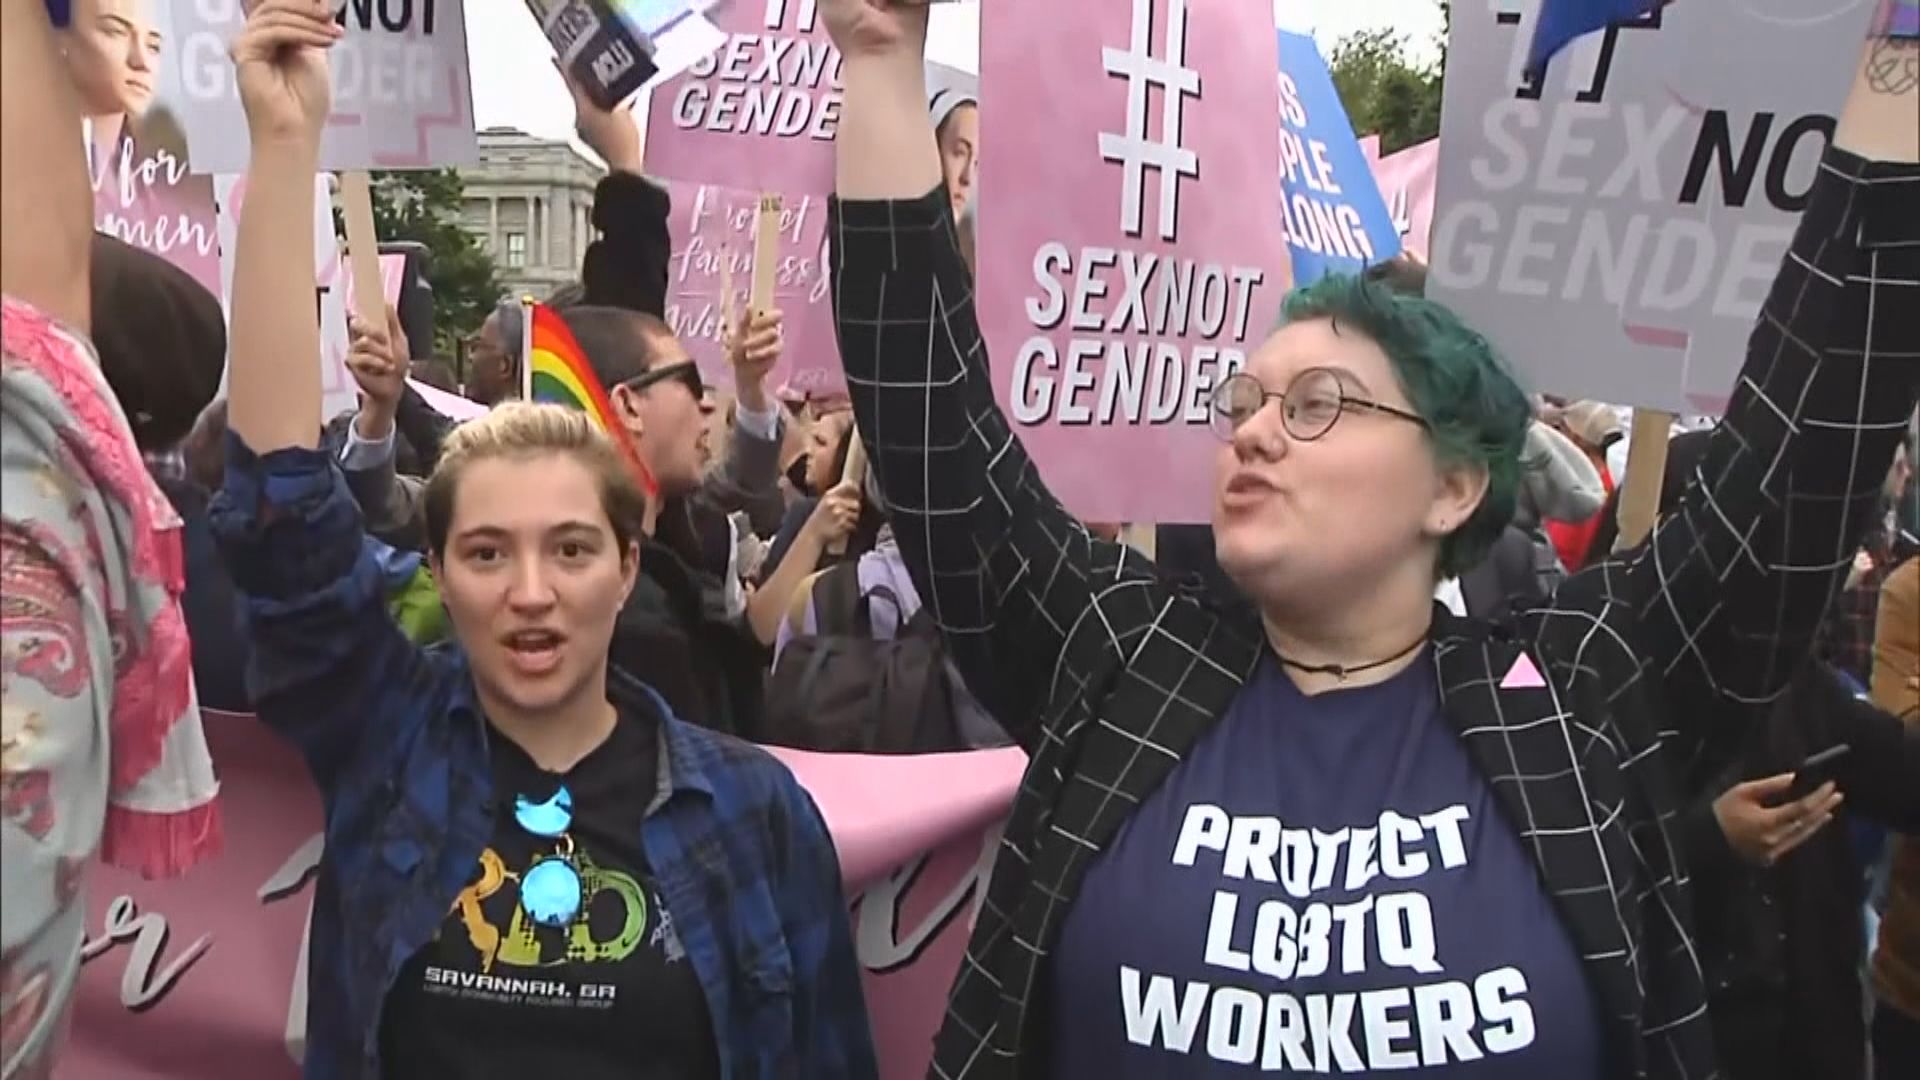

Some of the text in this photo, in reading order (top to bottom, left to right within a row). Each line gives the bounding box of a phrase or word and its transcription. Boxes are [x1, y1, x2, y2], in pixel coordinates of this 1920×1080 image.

[181, 31, 433, 101] GDER
[672, 80, 844, 141] GENDE
[119, 136, 188, 207] for
[1279, 127, 1342, 195] PLE
[1470, 103, 1838, 213] SEXNO
[1280, 188, 1374, 260] LONG
[1433, 202, 1796, 320] GENDE
[1025, 242, 1264, 342] SEXNOT
[1172, 803, 1470, 898] PROTECT
[1203, 890, 1444, 980] LGBTQ
[1119, 965, 1536, 1073] WORKERS
